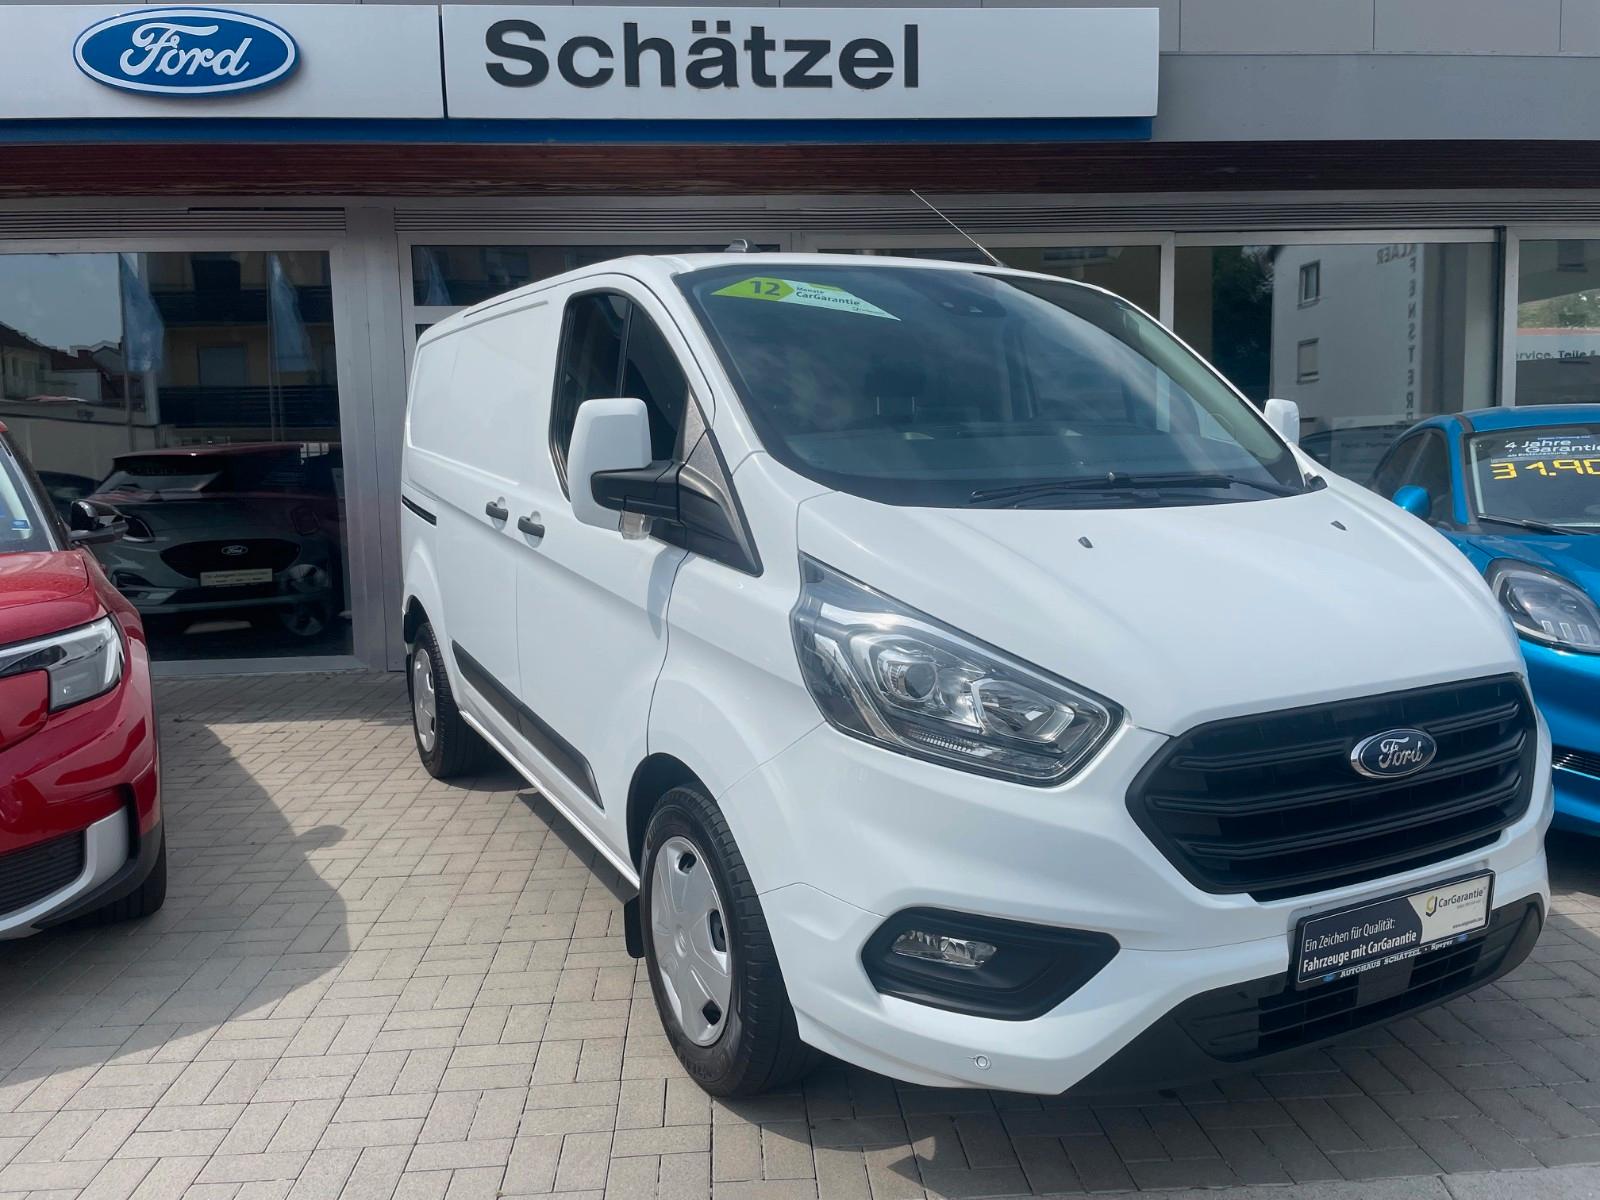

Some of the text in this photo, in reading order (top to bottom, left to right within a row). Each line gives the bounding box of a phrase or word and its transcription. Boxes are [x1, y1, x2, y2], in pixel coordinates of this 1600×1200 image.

[119, 22, 252, 77] Ford
[485, 19, 919, 90] Schätzel
[750, 280, 781, 297] 12
[795, 290, 861, 306] CarGarantie
[1505, 441, 1517, 449] 4
[1521, 438, 1571, 450] Jahre
[1379, 736, 1423, 769] Ford
[1438, 888, 1483, 908] CarGarantie
[1305, 917, 1395, 953] Ein Zeichen für Qualität:
[1303, 930, 1417, 974] Fahrzeuge mit CarGarantie
[1340, 960, 1382, 978] AUTOHAUS
